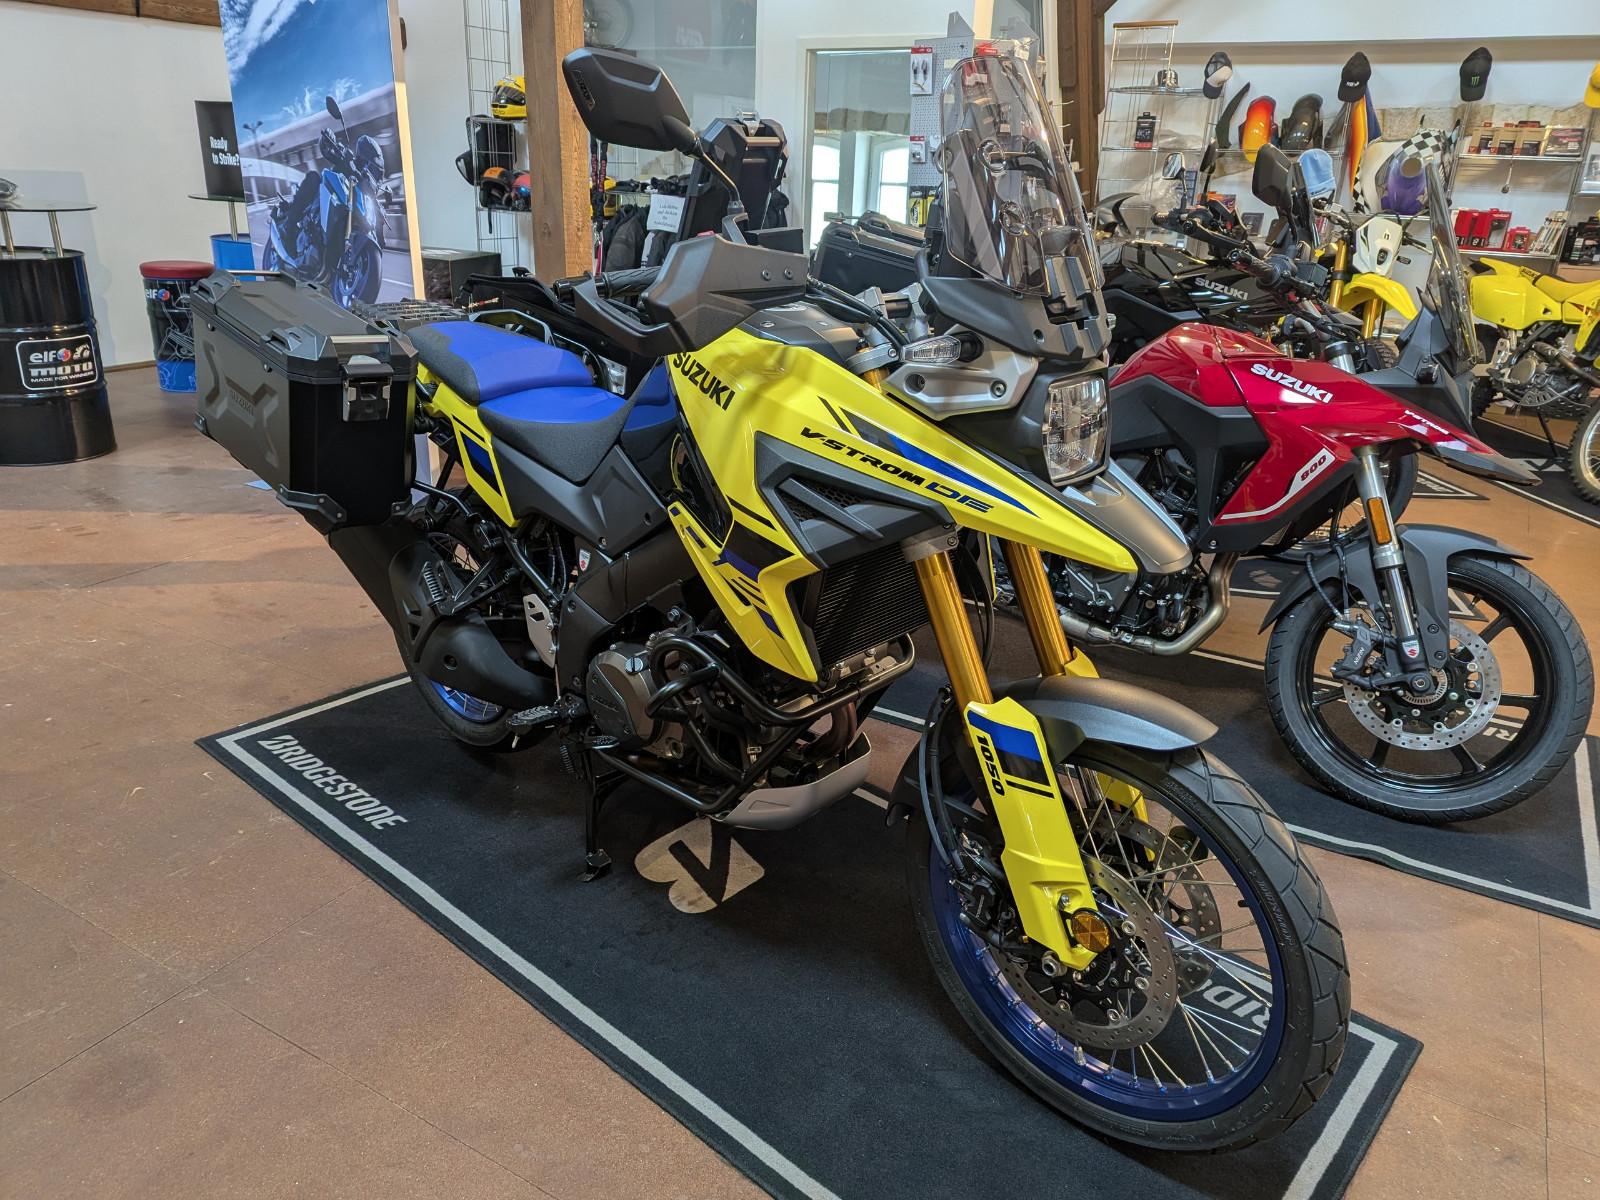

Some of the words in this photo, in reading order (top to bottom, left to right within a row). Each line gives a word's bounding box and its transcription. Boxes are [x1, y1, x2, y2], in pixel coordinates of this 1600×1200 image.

[210, 136, 228, 152] Ready
[212, 153, 219, 165] to
[219, 152, 240, 166] Strike?
[1194, 277, 1249, 300] SUZUKI
[29, 350, 57, 363] elf
[673, 352, 736, 411] SUZUKI
[1250, 363, 1334, 404] SUZUKI
[800, 426, 926, 486] V-STROM
[924, 481, 995, 514] DE
[1301, 454, 1327, 481] 800
[256, 734, 409, 830] BRIDGESTONE
[976, 735, 1006, 797] 1050
